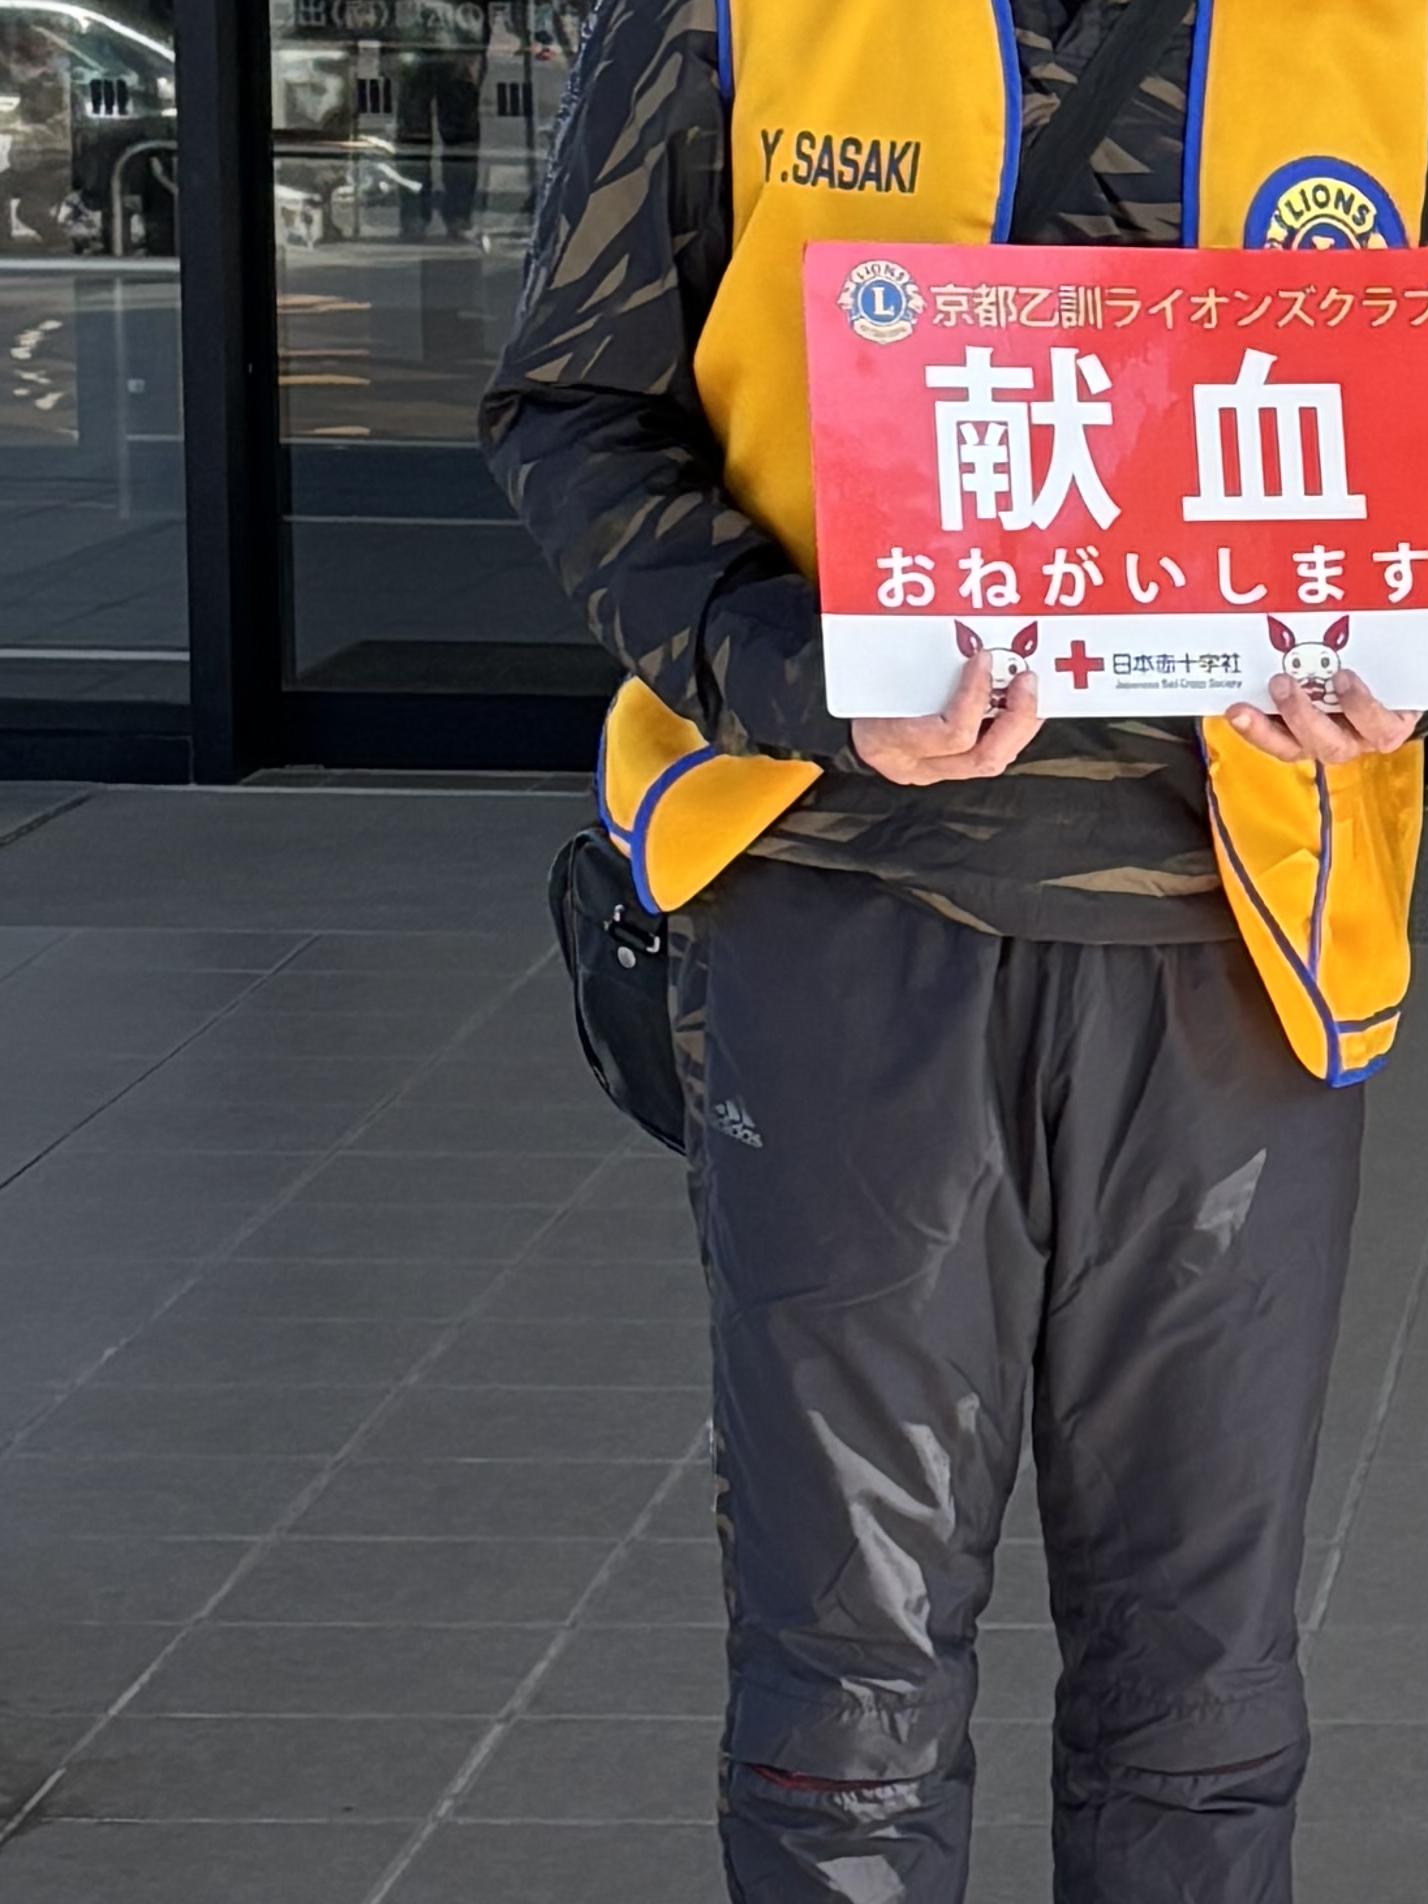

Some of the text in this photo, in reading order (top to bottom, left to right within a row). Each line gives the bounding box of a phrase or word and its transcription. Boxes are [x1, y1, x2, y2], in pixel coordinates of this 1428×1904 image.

[760, 129, 921, 195] Y.SASAKI
[1284, 183, 1371, 227] LIONS
[925, 345, 1367, 532] 献血
[1113, 652, 1242, 675] 日本赤十字社
